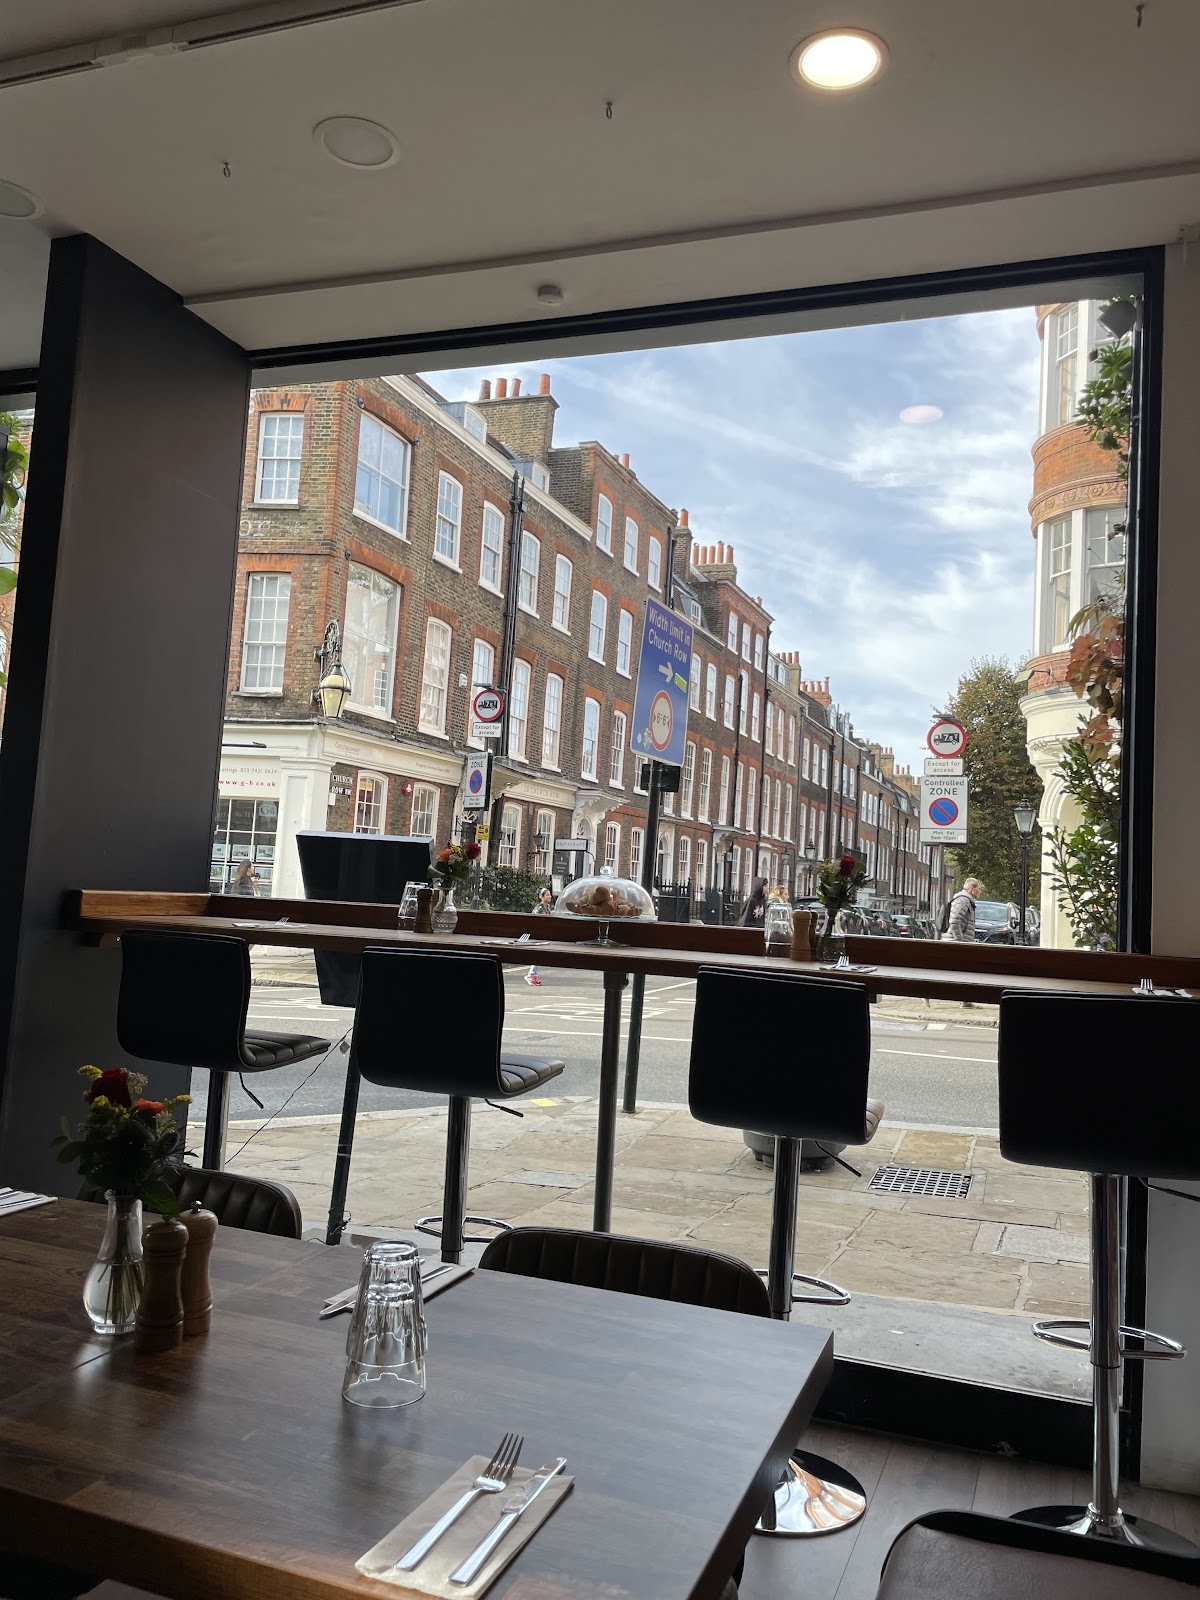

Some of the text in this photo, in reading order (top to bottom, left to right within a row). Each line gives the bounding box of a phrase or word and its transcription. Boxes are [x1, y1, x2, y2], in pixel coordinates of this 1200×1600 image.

[650, 606, 690, 646] Width limit in
[648, 628, 688, 664] Church Row
